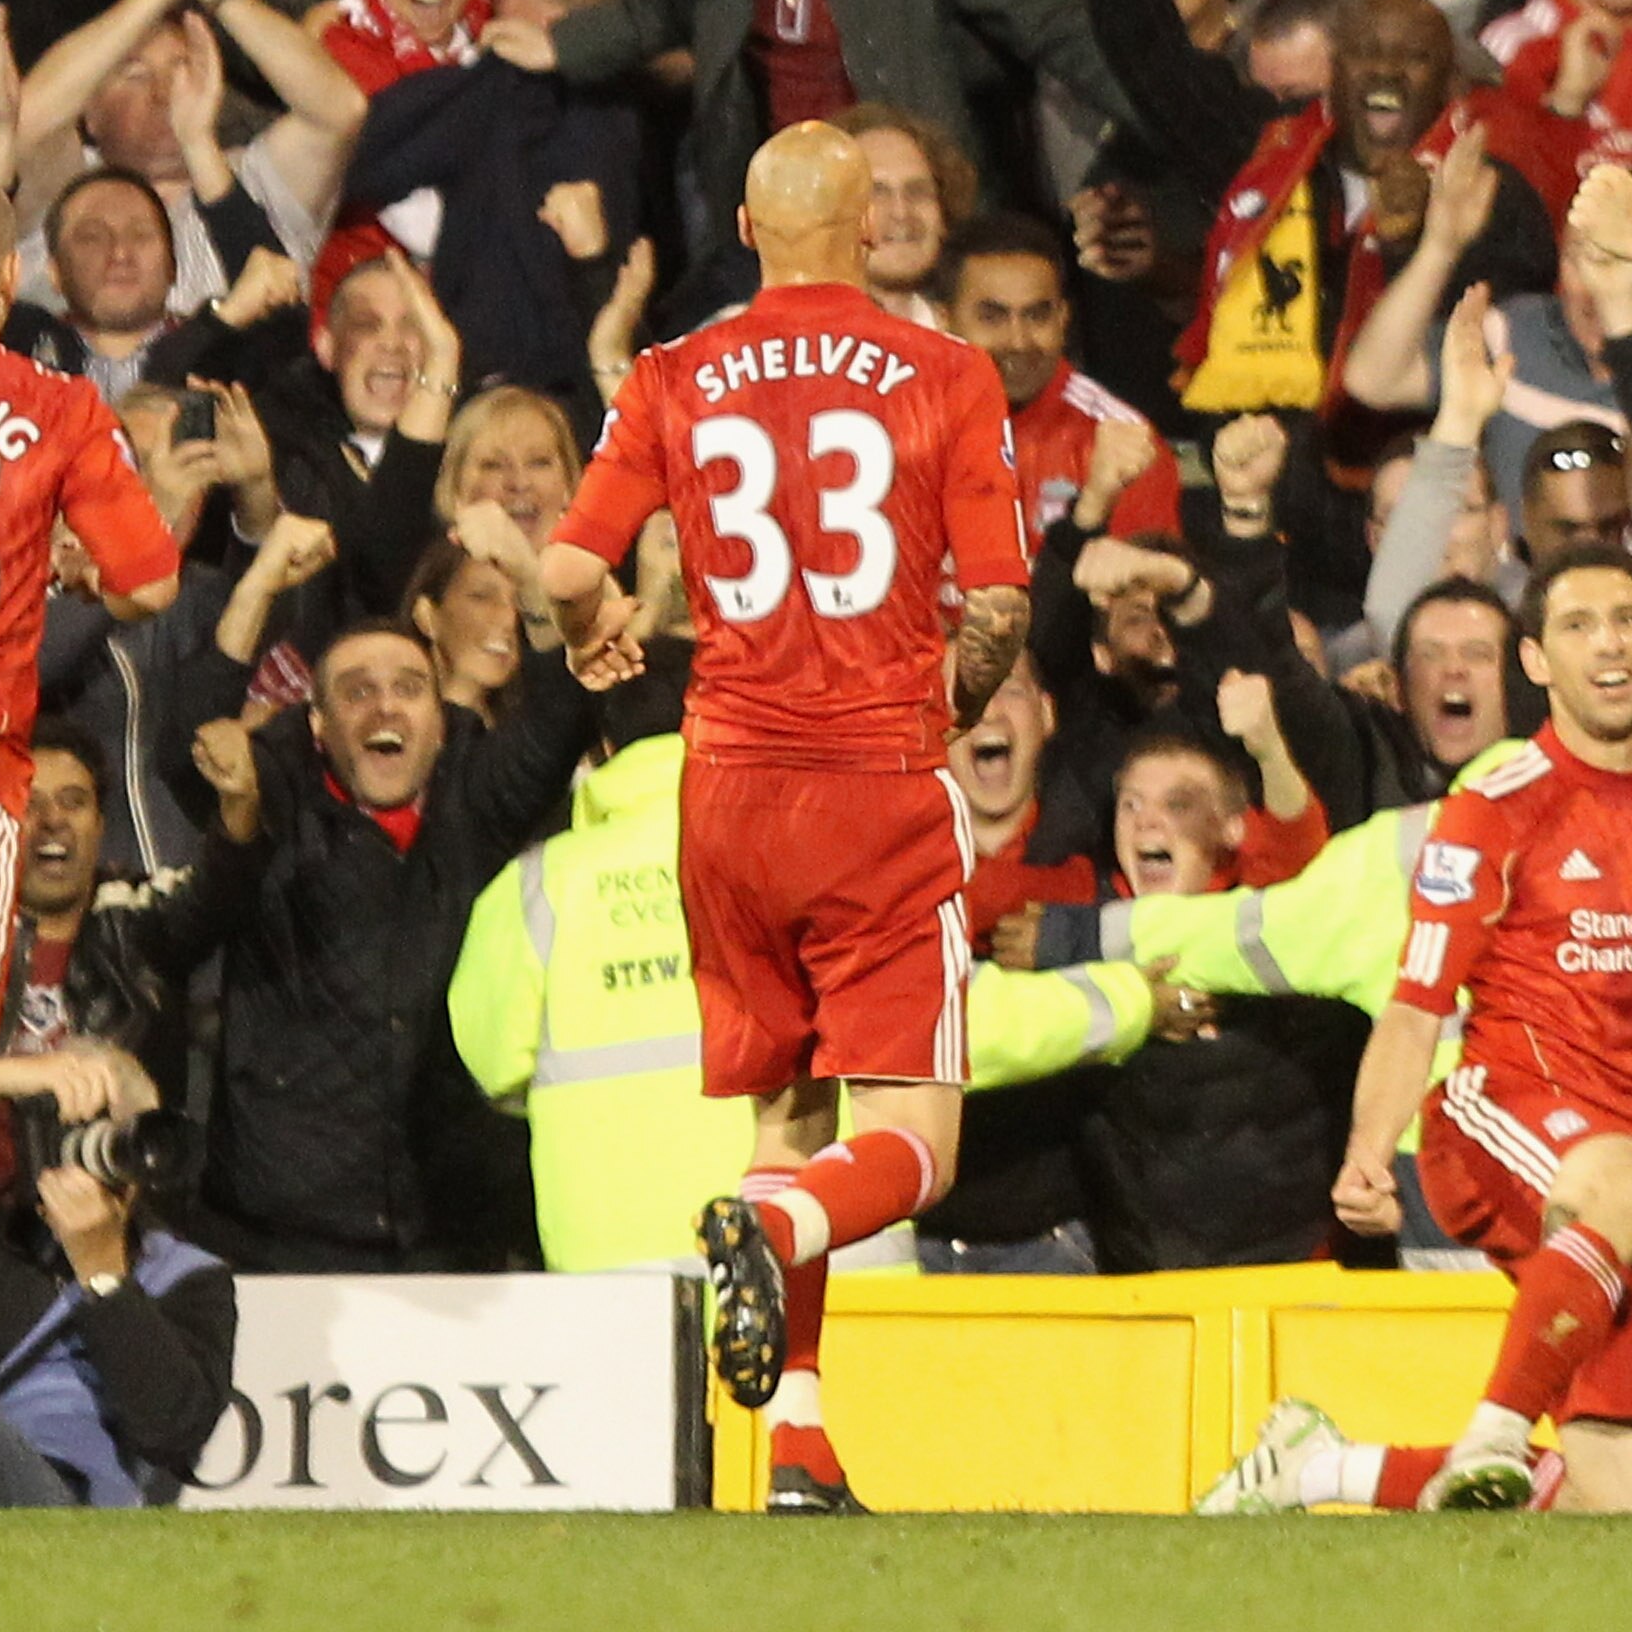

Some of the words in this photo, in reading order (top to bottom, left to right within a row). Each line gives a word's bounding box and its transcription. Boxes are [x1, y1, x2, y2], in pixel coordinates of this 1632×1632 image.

[694, 334, 917, 403] SHELVEY
[691, 408, 899, 623] 33
[603, 953, 688, 990] STEW
